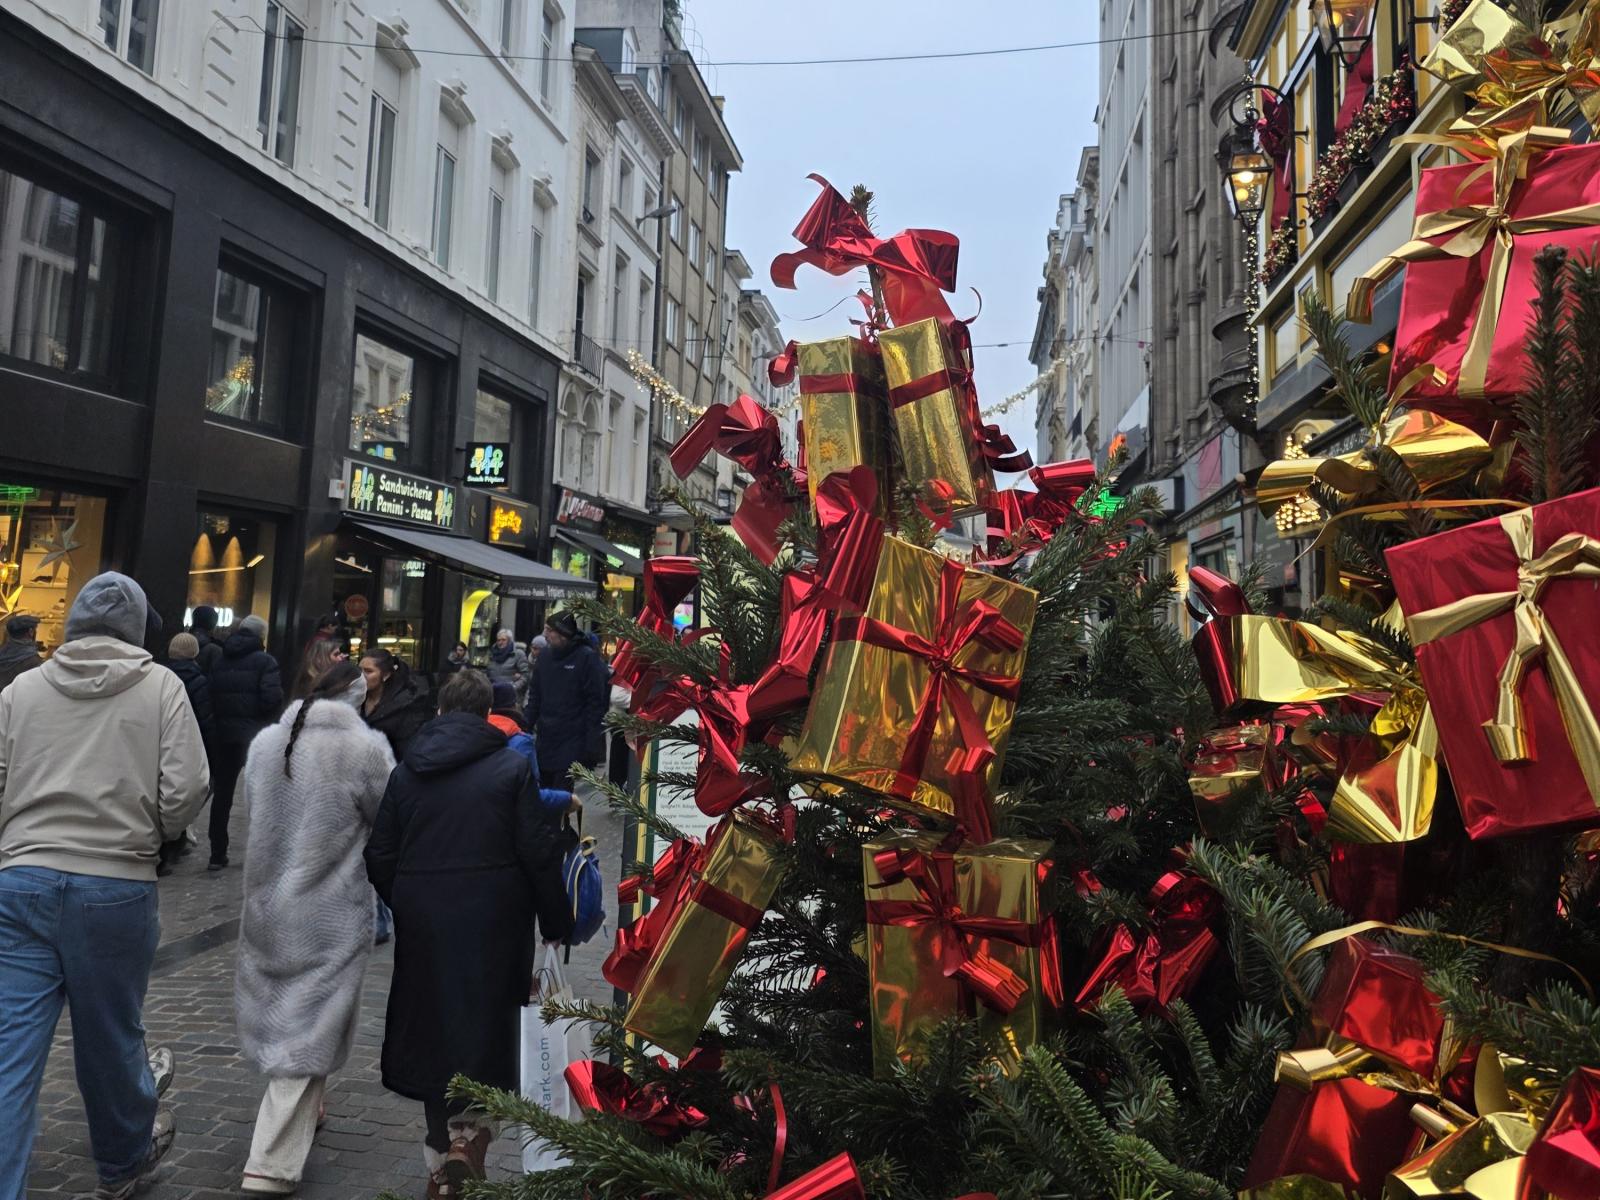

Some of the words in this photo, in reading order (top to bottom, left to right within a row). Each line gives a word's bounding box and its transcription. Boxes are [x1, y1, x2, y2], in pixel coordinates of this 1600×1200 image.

[379, 473, 433, 502] Sandwicherie
[376, 494, 404, 516] Panini
[411, 502, 432, 521] Pasta
